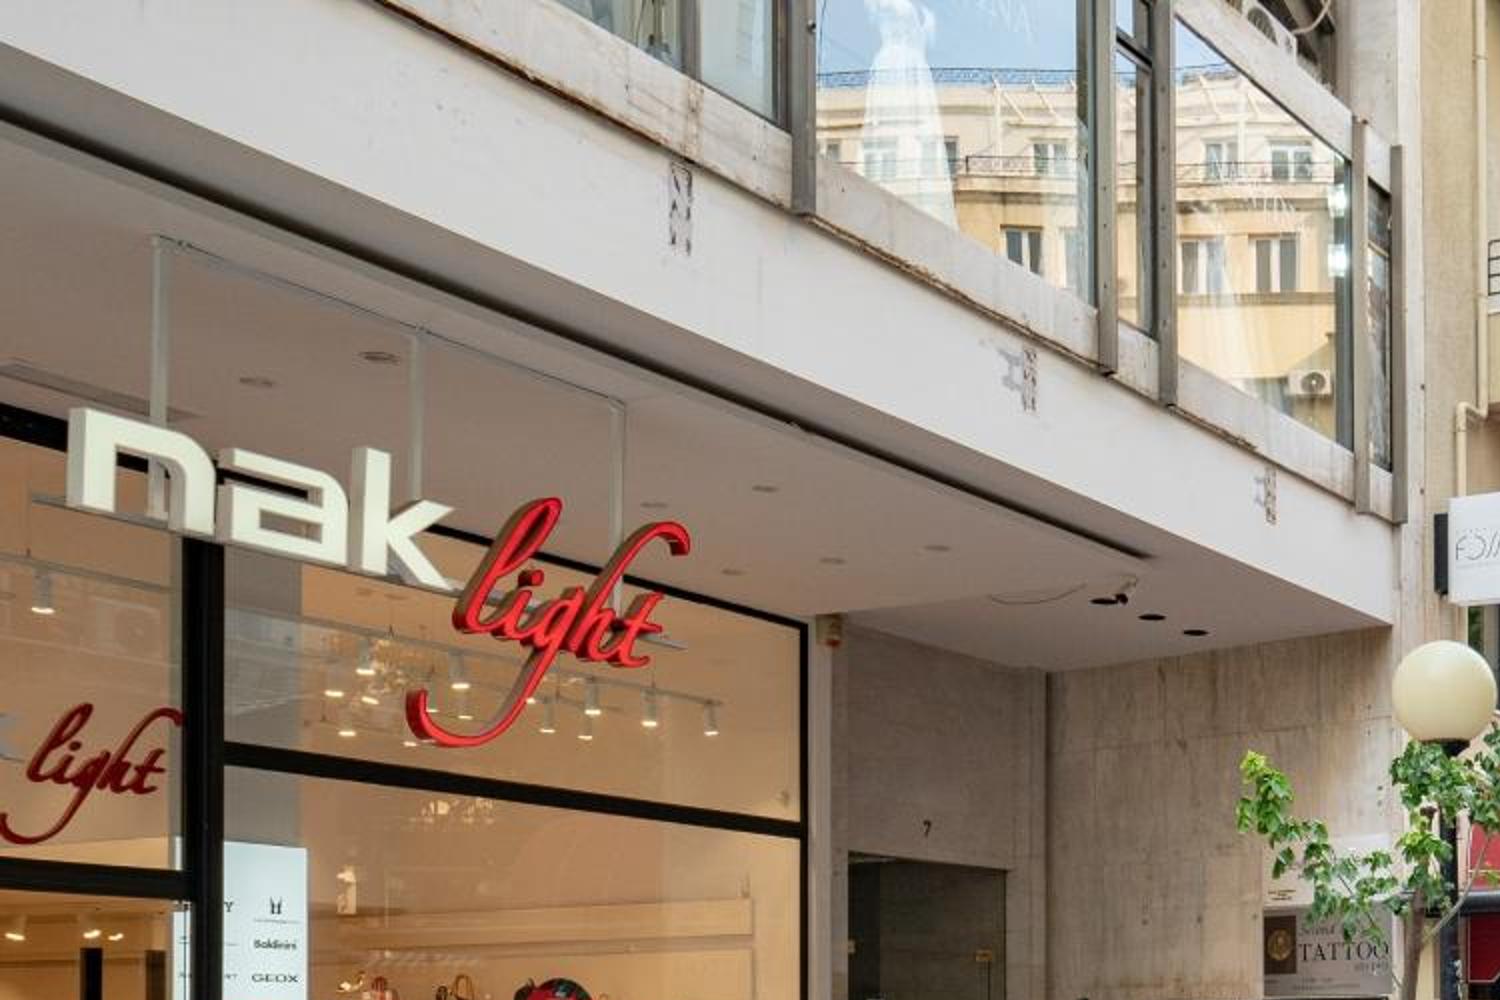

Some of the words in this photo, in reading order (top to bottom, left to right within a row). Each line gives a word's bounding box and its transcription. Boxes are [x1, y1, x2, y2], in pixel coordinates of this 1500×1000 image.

[66, 408, 454, 591] nak
[405, 497, 691, 748] light
[0, 702, 184, 845] light
[251, 973, 299, 983] GEOX
[1299, 942, 1389, 961] TATTOO
